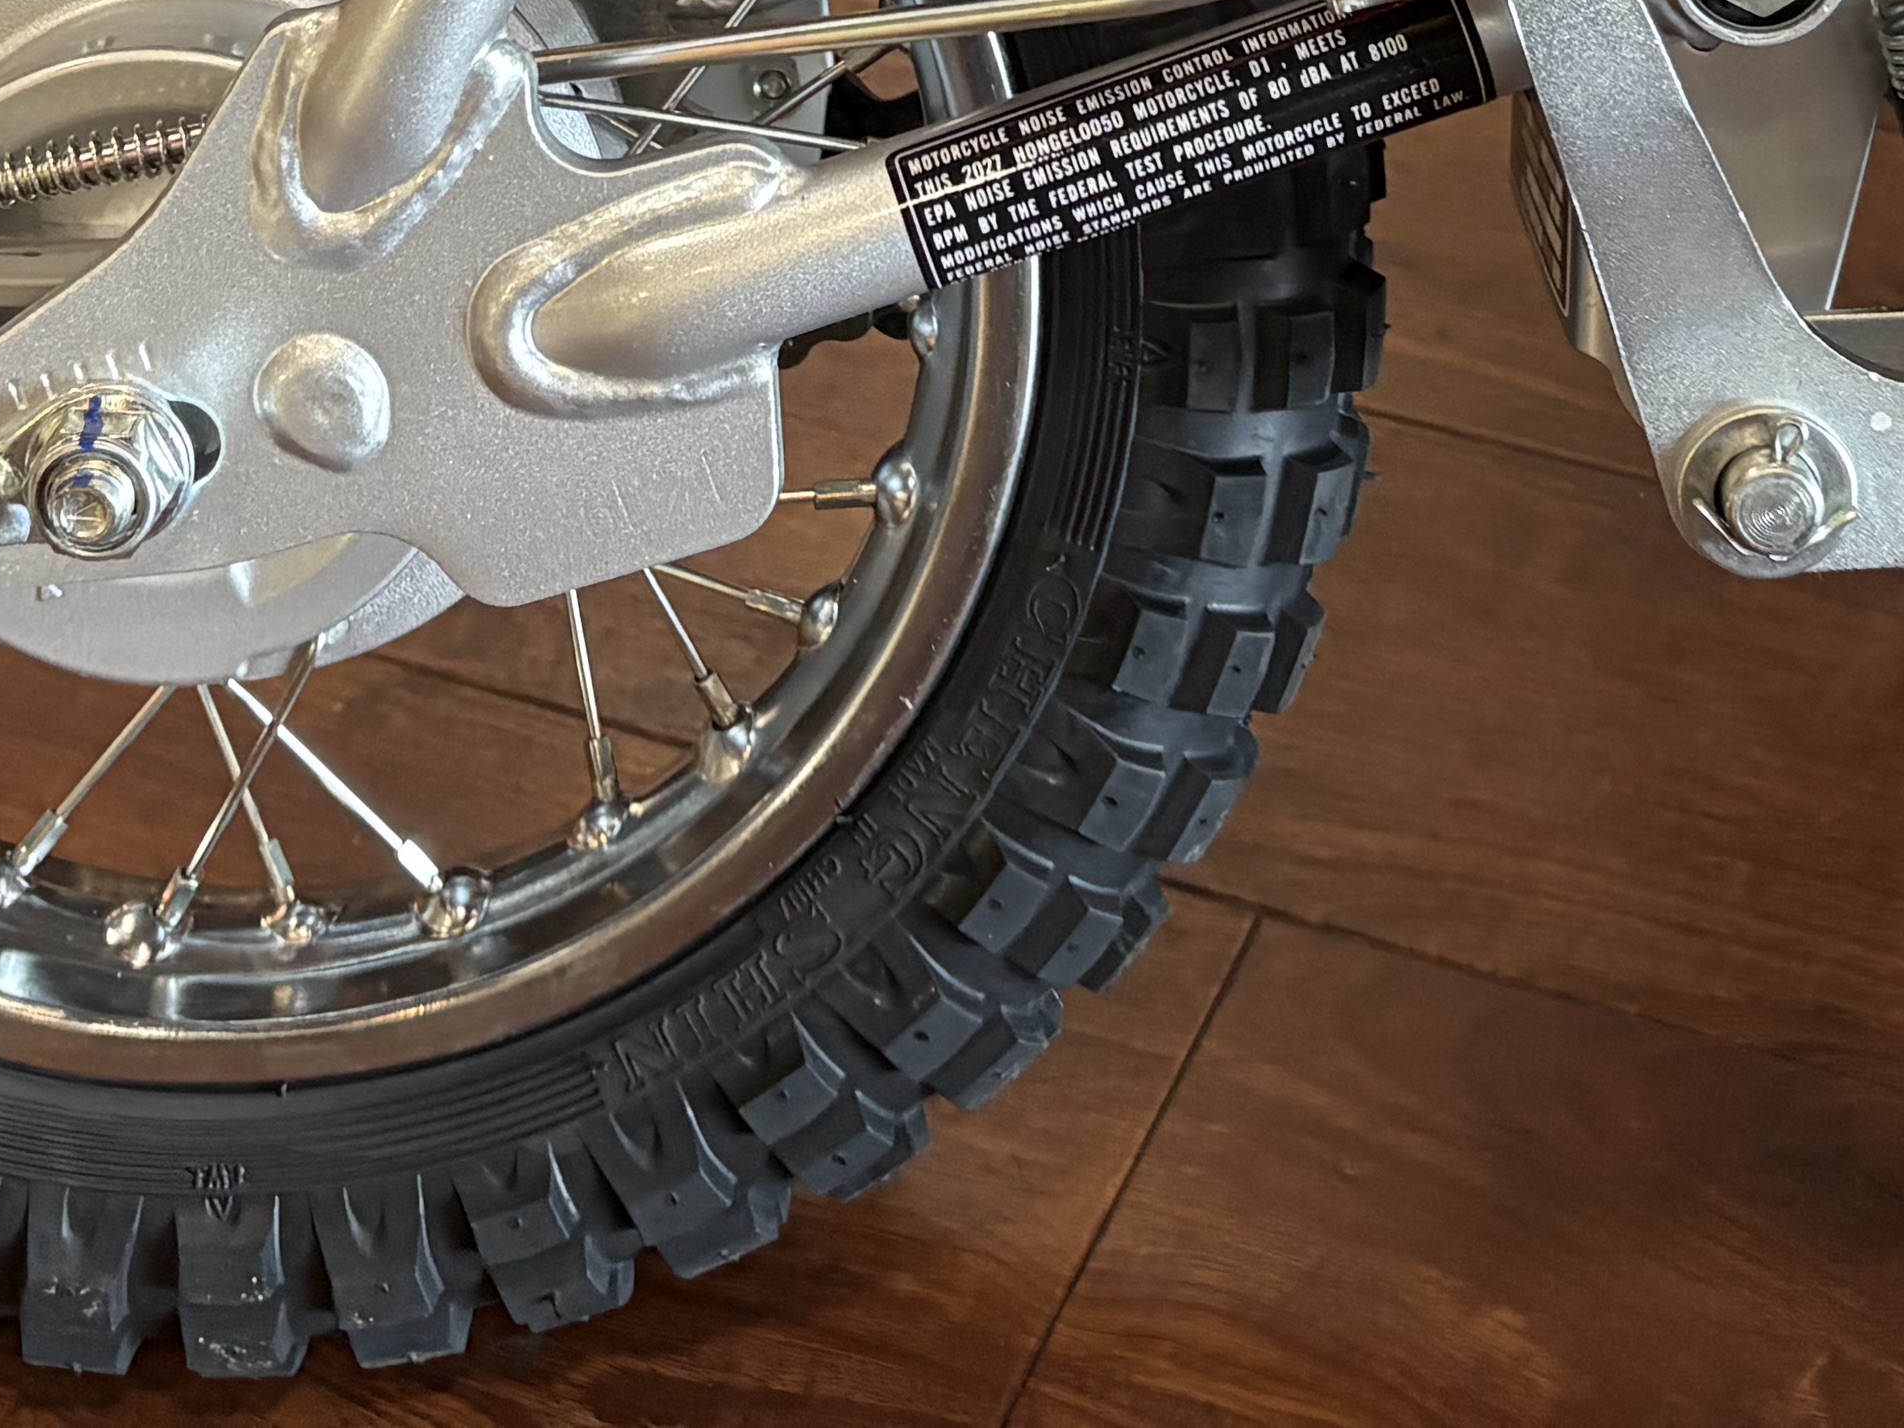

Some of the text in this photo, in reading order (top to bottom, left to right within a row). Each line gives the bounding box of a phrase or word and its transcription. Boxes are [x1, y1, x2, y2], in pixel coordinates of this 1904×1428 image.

[905, 123, 1012, 178] MOTORCYCLE
[1016, 103, 1069, 138] NOISE
[1073, 72, 1155, 117] EMISSION
[1159, 41, 1236, 86] CONTROL
[912, 169, 953, 199] THIS
[959, 150, 1006, 183] 2027
[1293, 27, 1349, 64] MEETS
[922, 31, 1412, 228] EPA NOISE EMISSION REQUIREMENTS OF 80 dBA AT 8100
[938, 212, 1065, 271] MODIFICATIONS
[1070, 190, 1128, 226] WHICH
[1133, 168, 1188, 204] CAUSE
[1193, 151, 1235, 182] THIS
[1240, 110, 1344, 165] MOTORCYCLE
[1349, 99, 1375, 125] TO
[1380, 75, 1443, 113] EXCEED
[930, 221, 971, 252] RPM
[975, 210, 1002, 236] BY
[1006, 195, 1042, 225] THE
[1046, 167, 1120, 211] FEDERAL
[1123, 150, 1167, 183] TEST
